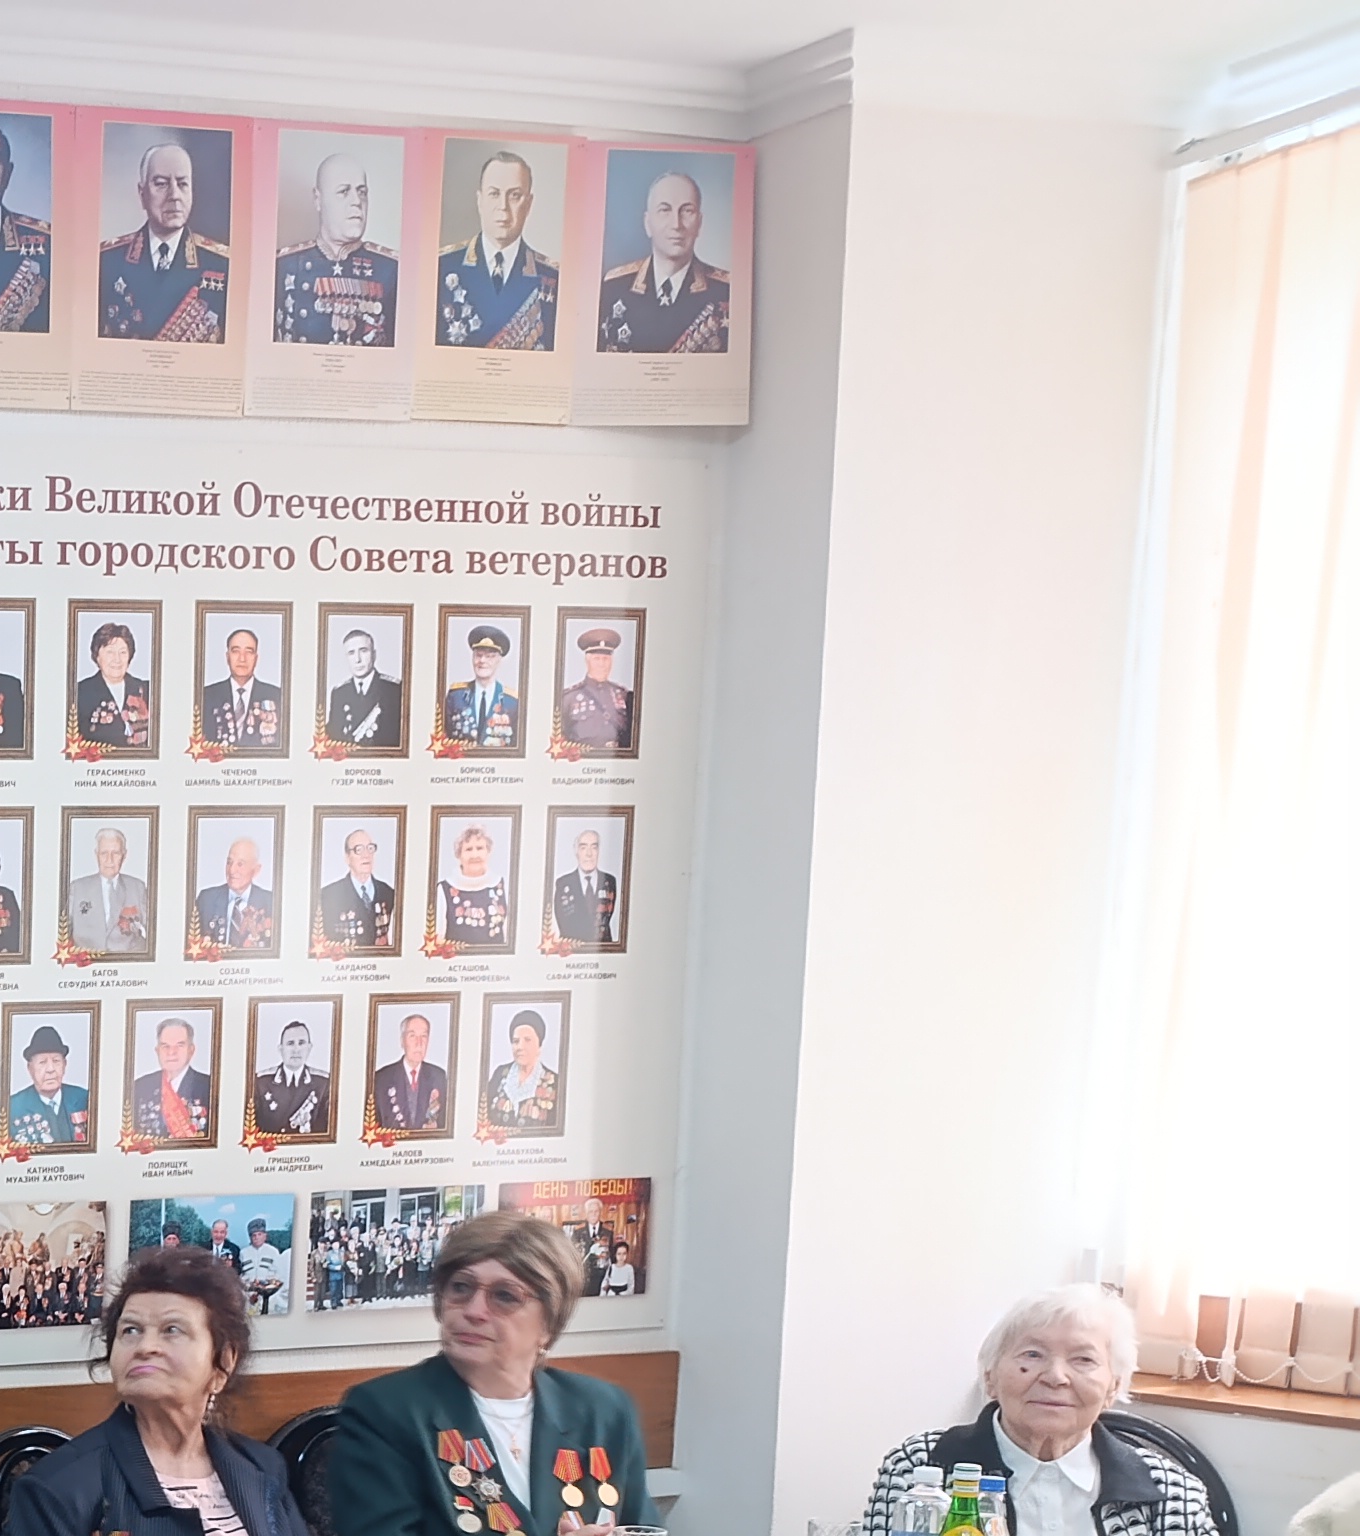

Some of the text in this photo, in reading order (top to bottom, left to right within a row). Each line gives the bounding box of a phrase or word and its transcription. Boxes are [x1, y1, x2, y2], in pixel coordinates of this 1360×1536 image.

[44, 475, 221, 518] Великой
[232, 481, 529, 525] Отечественной
[541, 494, 662, 529] войны
[56, 538, 296, 577] городского
[308, 535, 453, 574] Совета
[465, 552, 668, 585] ветеранов
[221, 768, 257, 776] ЧЕЧЕНОВ
[345, 768, 381, 776] ВОРОКОВ
[100, 779, 157, 787] МИХАЙЛОВНА
[184, 779, 220, 787] ШАМИЛЬ
[357, 778, 393, 786] МАТОВИЧ
[594, 777, 635, 785] ЕФИМОВИЧ
[335, 963, 377, 972] КАРДАНОВ
[448, 964, 489, 972] АСТАШОВА
[92, 969, 118, 977] БАГОВ
[574, 971, 617, 980] ИСХАКОВИЧ
[350, 974, 390, 982] ЯКУБОВИЧ
[58, 979, 148, 989] СЕФУДИН ХАТАЛОВИЧ
[392, 1150, 423, 1158] НАЛОЕВ
[268, 1156, 310, 1164] ГРИЩЕНКО
[359, 1157, 454, 1167] АХМЕДХАН ХАМУРЗОВИЧ
[472, 1156, 567, 1167] ВАЛЕНТИНА МИХАЙЛОВНА
[148, 1161, 188, 1169] ПОЛИЩУК
[253, 1164, 324, 1173] ИВАН АНДРЕЕВИЧ
[26, 1166, 65, 1174] КАТИНОВ
[142, 1169, 193, 1178] ИВАН ИЛЬИЧ
[6, 1173, 85, 1184] МУАЗИН ХАУТОВИЧ
[533, 1178, 633, 1199] ДЕНЬ ПОБЕДЫ!
